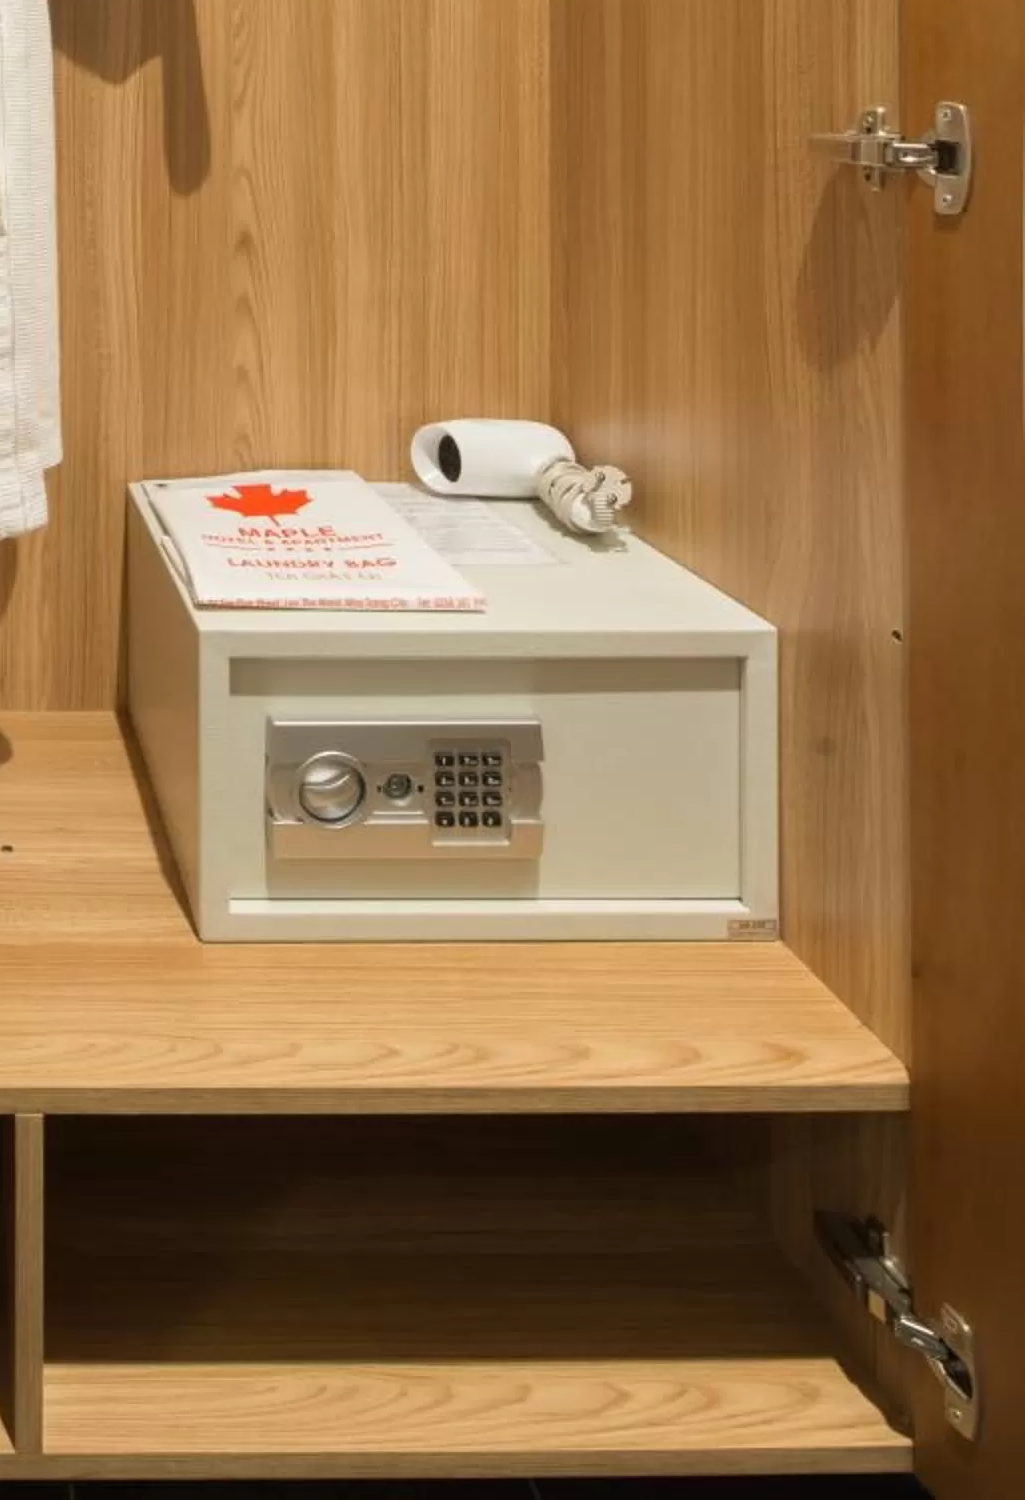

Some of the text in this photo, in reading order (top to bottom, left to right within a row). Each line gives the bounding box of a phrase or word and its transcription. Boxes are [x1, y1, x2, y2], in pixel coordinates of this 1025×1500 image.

[237, 526, 335, 538] MAPLE
[227, 556, 398, 568] LAUNDRY BAG
